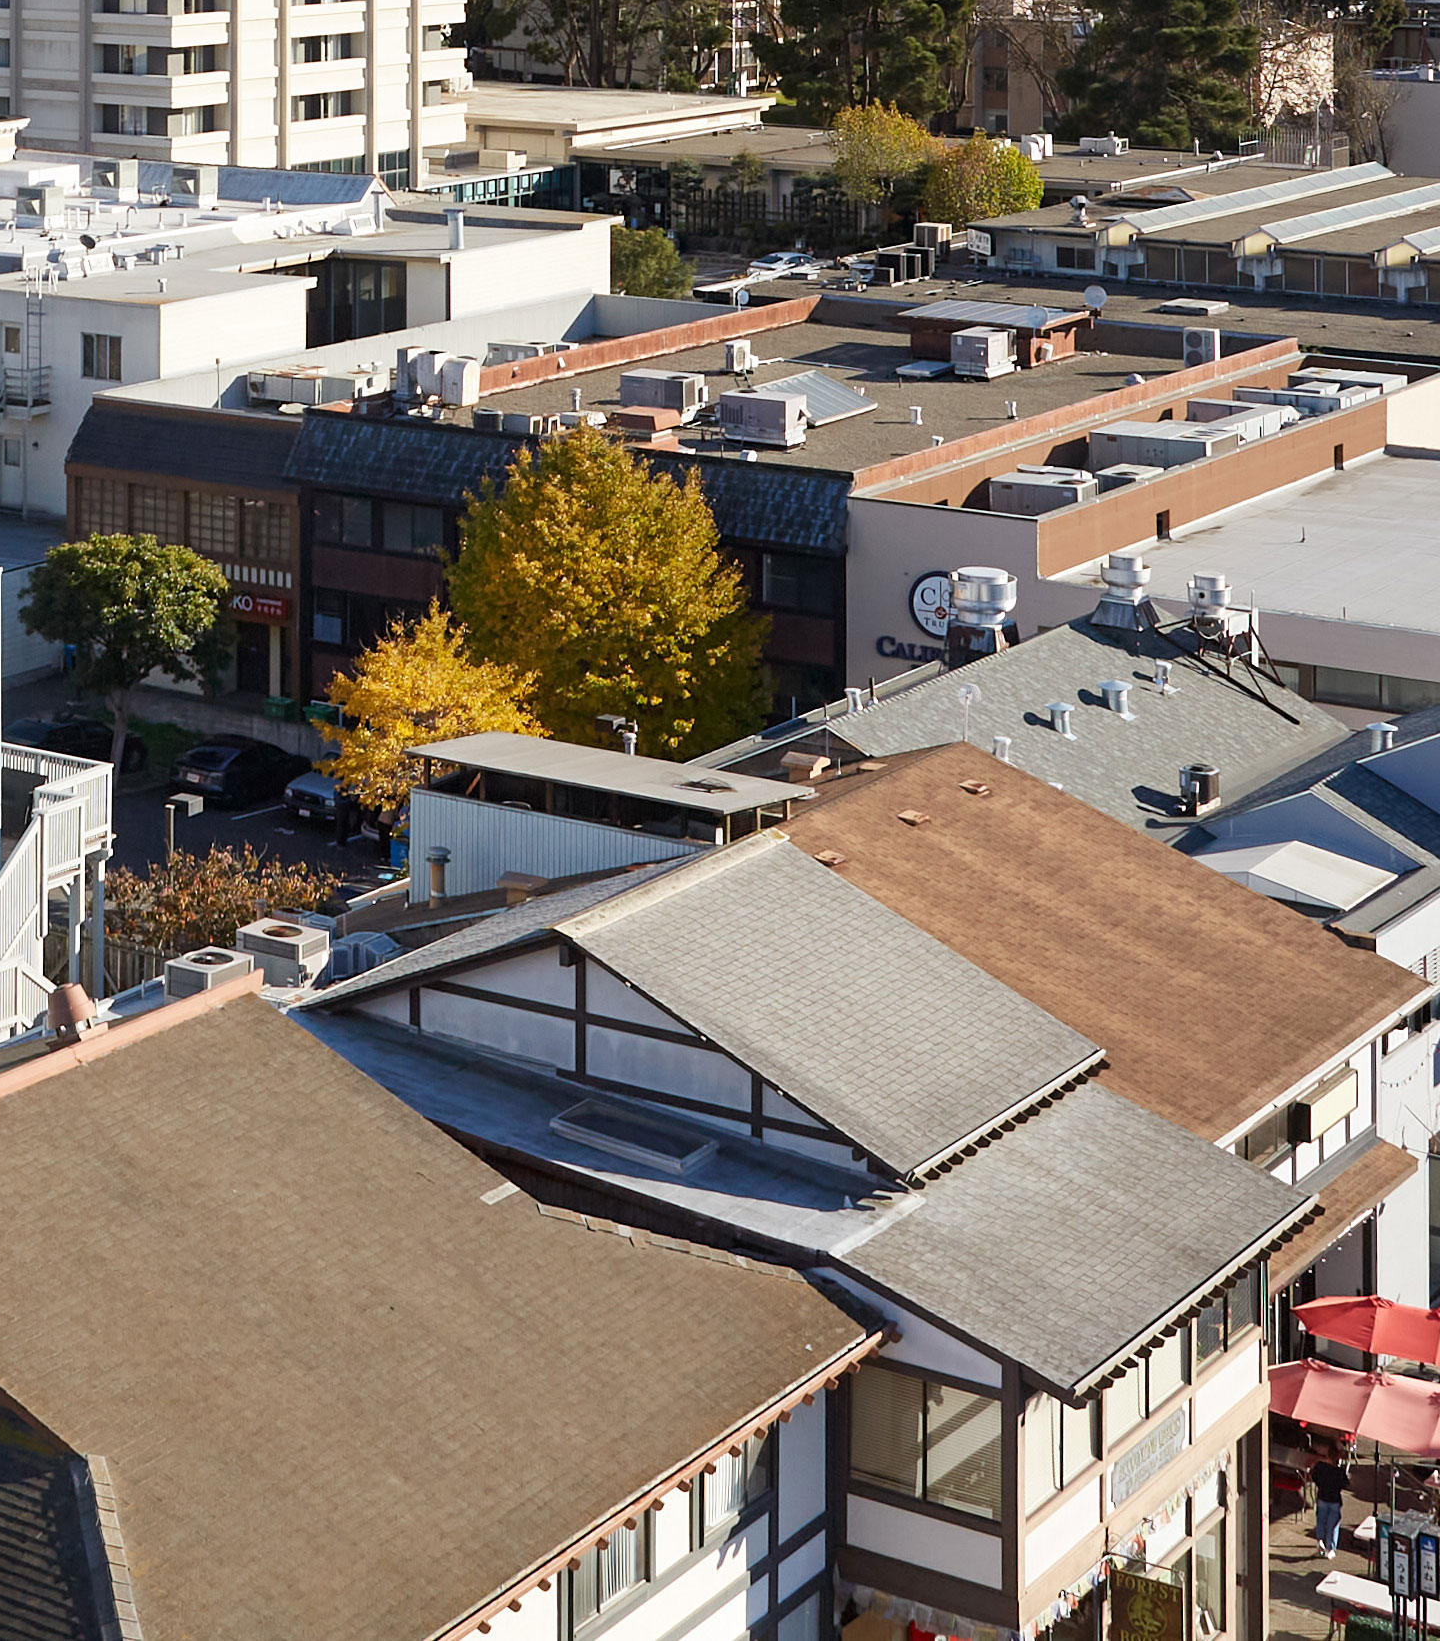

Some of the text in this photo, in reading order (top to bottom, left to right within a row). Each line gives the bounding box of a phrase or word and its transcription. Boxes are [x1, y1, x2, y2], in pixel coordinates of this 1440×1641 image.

[229, 595, 253, 611] KO
[924, 617, 945, 628] TRU
[1116, 1572, 1180, 1602] FOREST
